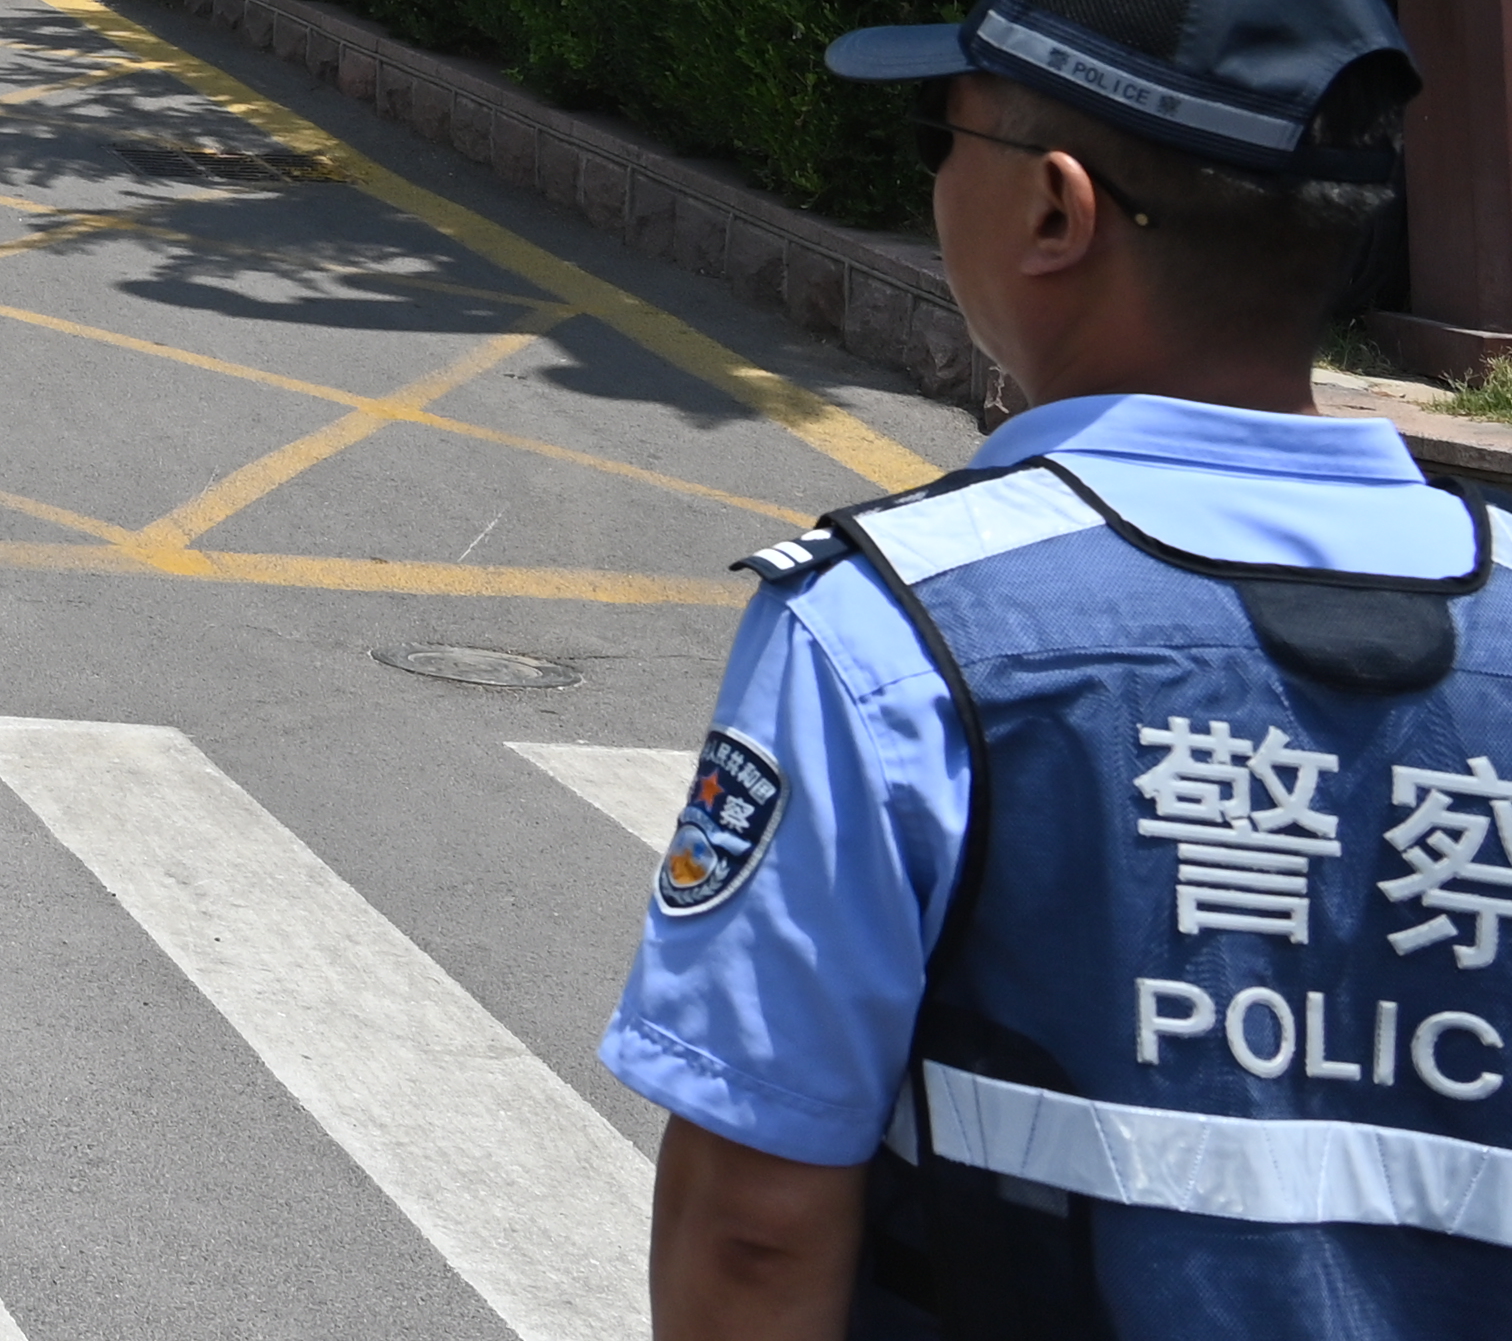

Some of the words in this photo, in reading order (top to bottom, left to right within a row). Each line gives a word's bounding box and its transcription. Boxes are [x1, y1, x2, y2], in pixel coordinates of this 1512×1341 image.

[1071, 60, 1152, 107] POLICE
[1132, 715, 1512, 971] 警察
[1134, 976, 1508, 1102] POLIC
